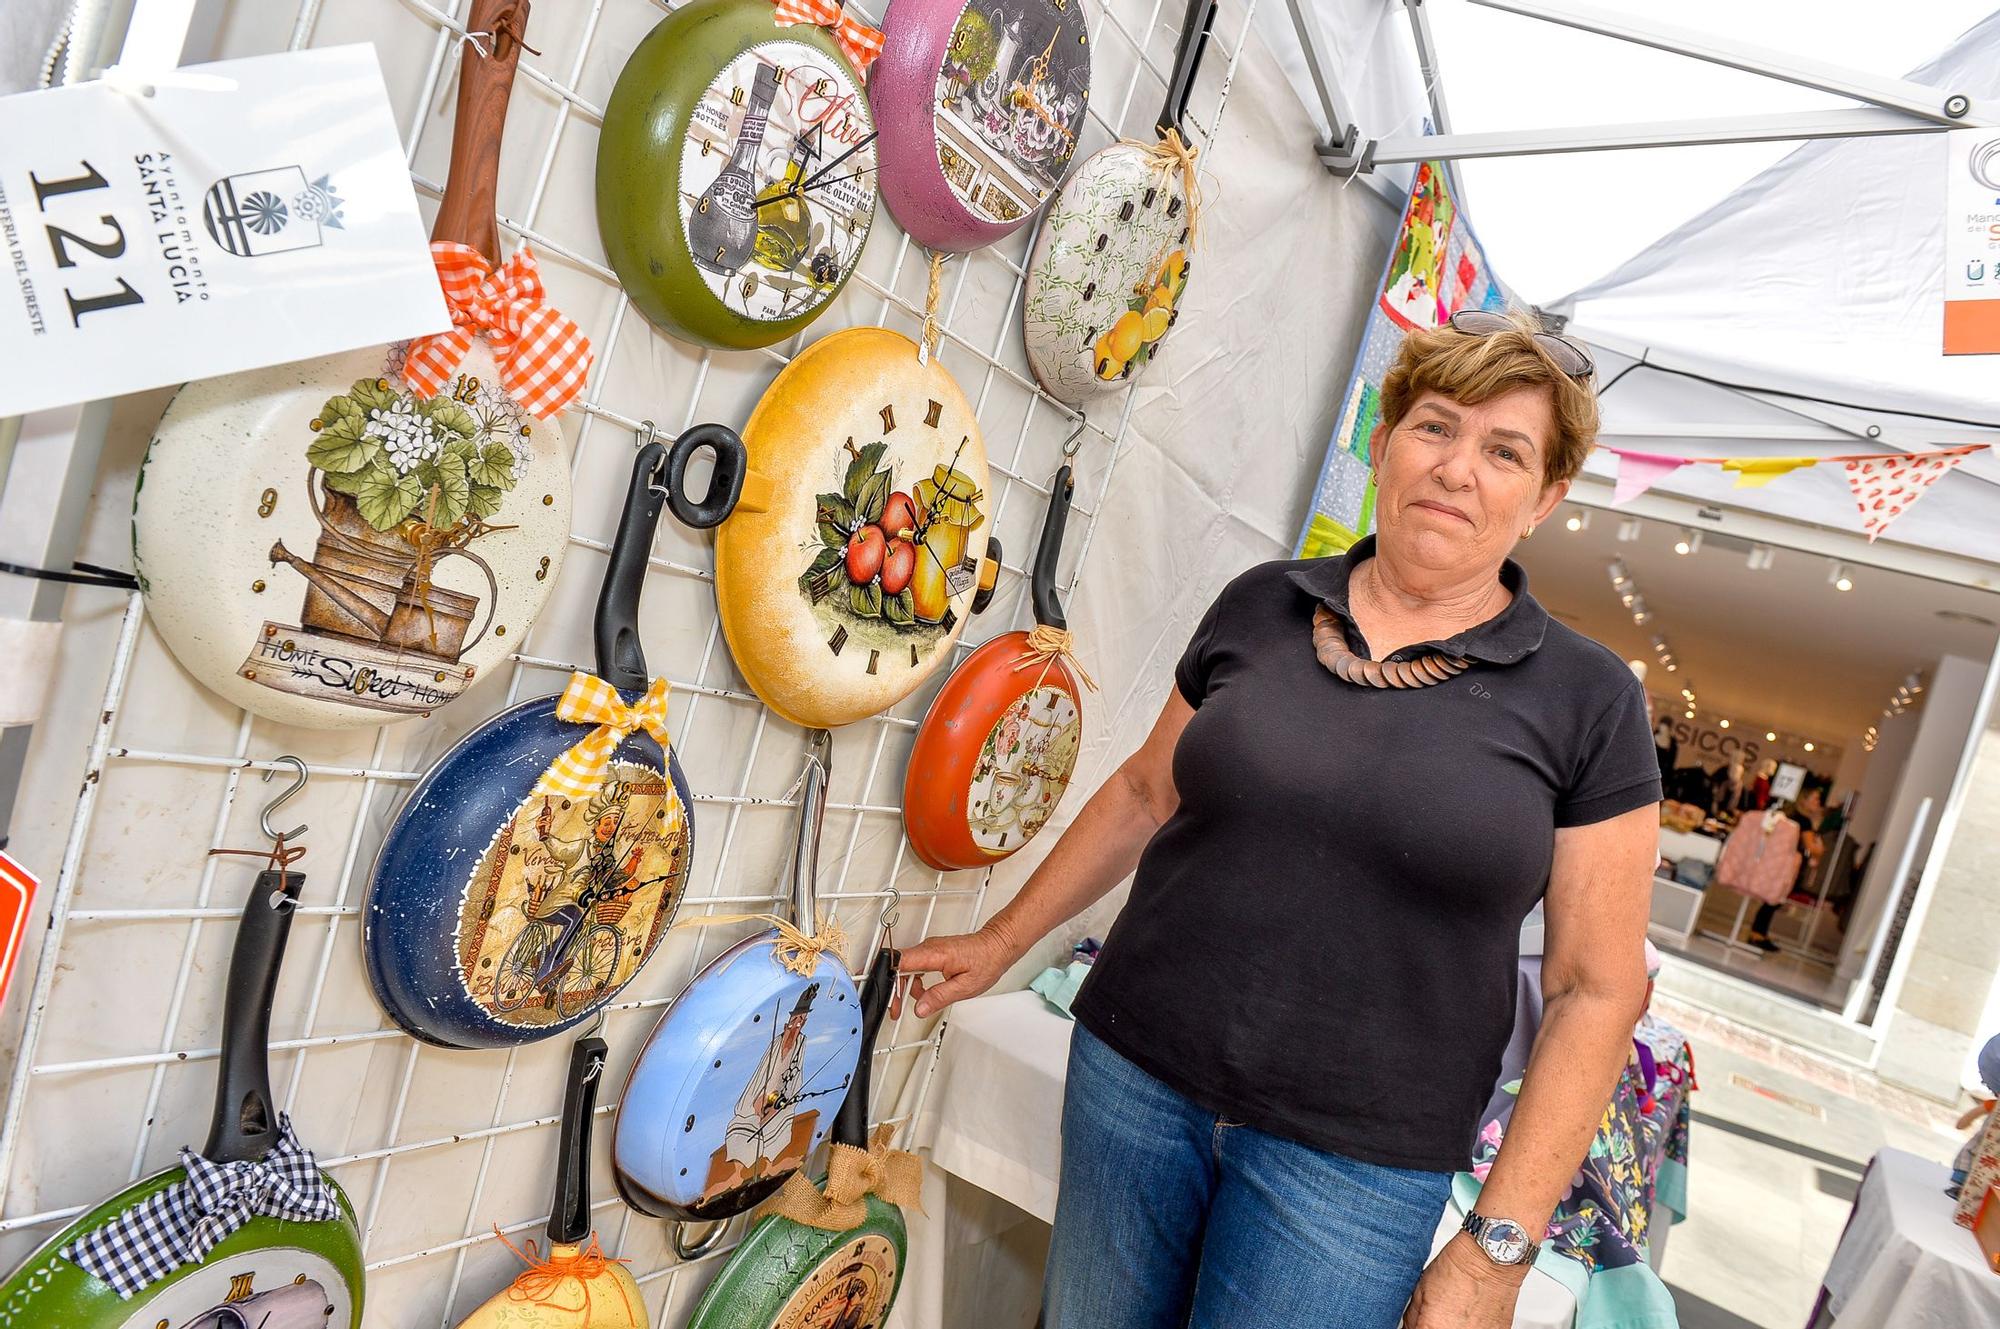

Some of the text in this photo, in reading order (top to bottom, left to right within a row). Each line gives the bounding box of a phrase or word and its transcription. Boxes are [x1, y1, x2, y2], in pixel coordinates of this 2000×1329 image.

[956, 31, 967, 51] 9
[730, 86, 744, 106] 10
[707, 106, 729, 121] HONEST
[702, 139, 711, 156] 9
[698, 197, 709, 214] 8
[833, 188, 857, 207] OLIVE
[857, 200, 868, 213] OIL
[135, 154, 192, 305] SANTA LUCIA
[158, 151, 209, 301] Ayuntamiento
[29, 159, 145, 328] 121
[714, 246, 726, 262] 7
[11, 250, 28, 276] DEL
[742, 282, 752, 298] 6
[19, 278, 46, 336] SURESTE
[453, 373, 480, 402] 12
[257, 487, 278, 519] 9
[536, 555, 551, 581] 3
[260, 638, 319, 667] HOME
[354, 666, 370, 695] 6
[611, 781, 630, 803] 12
[684, 1114, 696, 1133] 9
